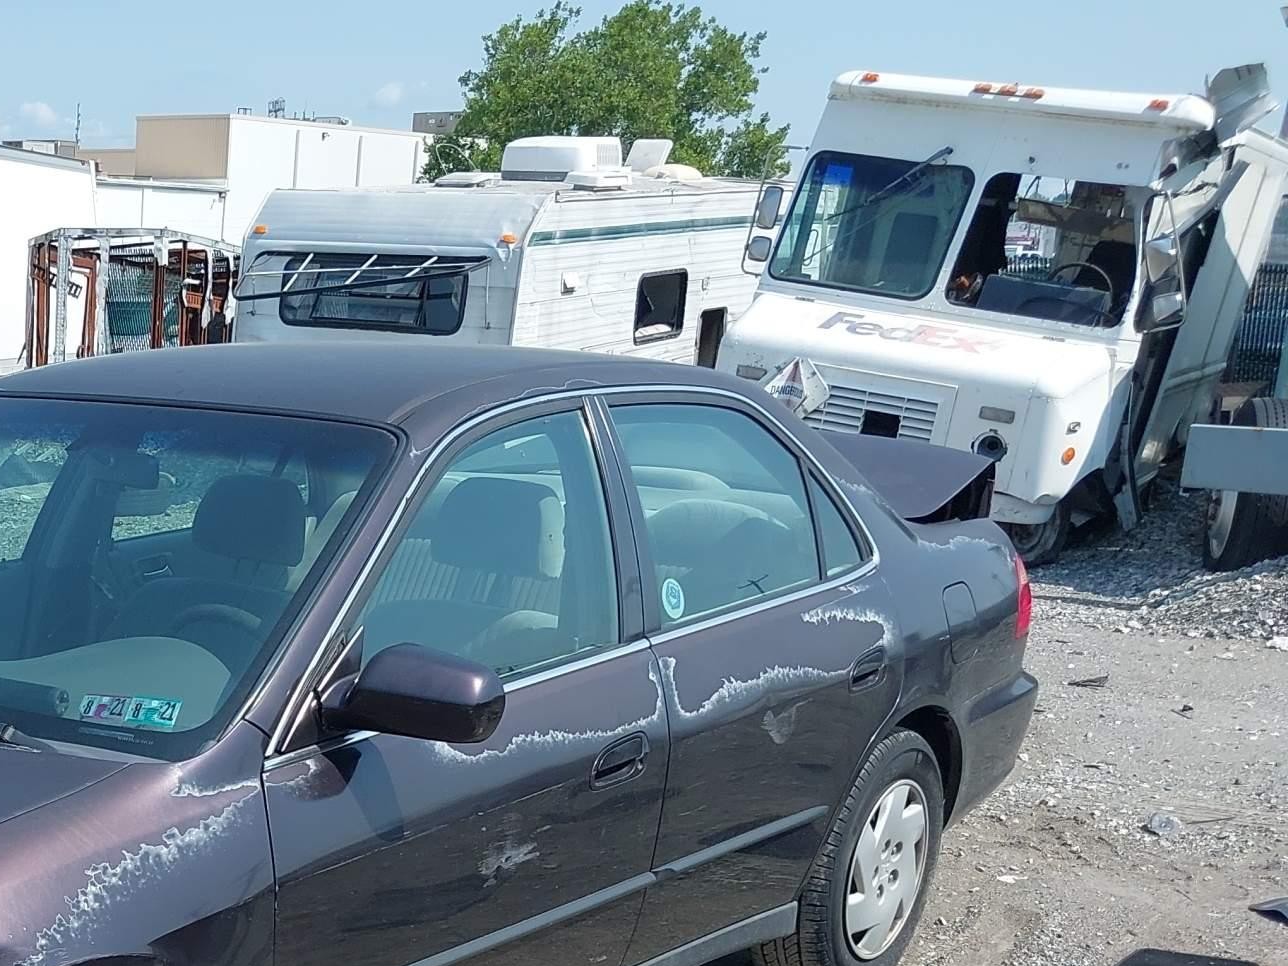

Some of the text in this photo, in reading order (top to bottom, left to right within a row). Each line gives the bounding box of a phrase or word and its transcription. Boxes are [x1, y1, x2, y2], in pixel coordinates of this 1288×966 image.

[817, 311, 995, 354] FedEx
[84, 699, 127, 716] 8 21
[132, 702, 176, 721] 8 21
